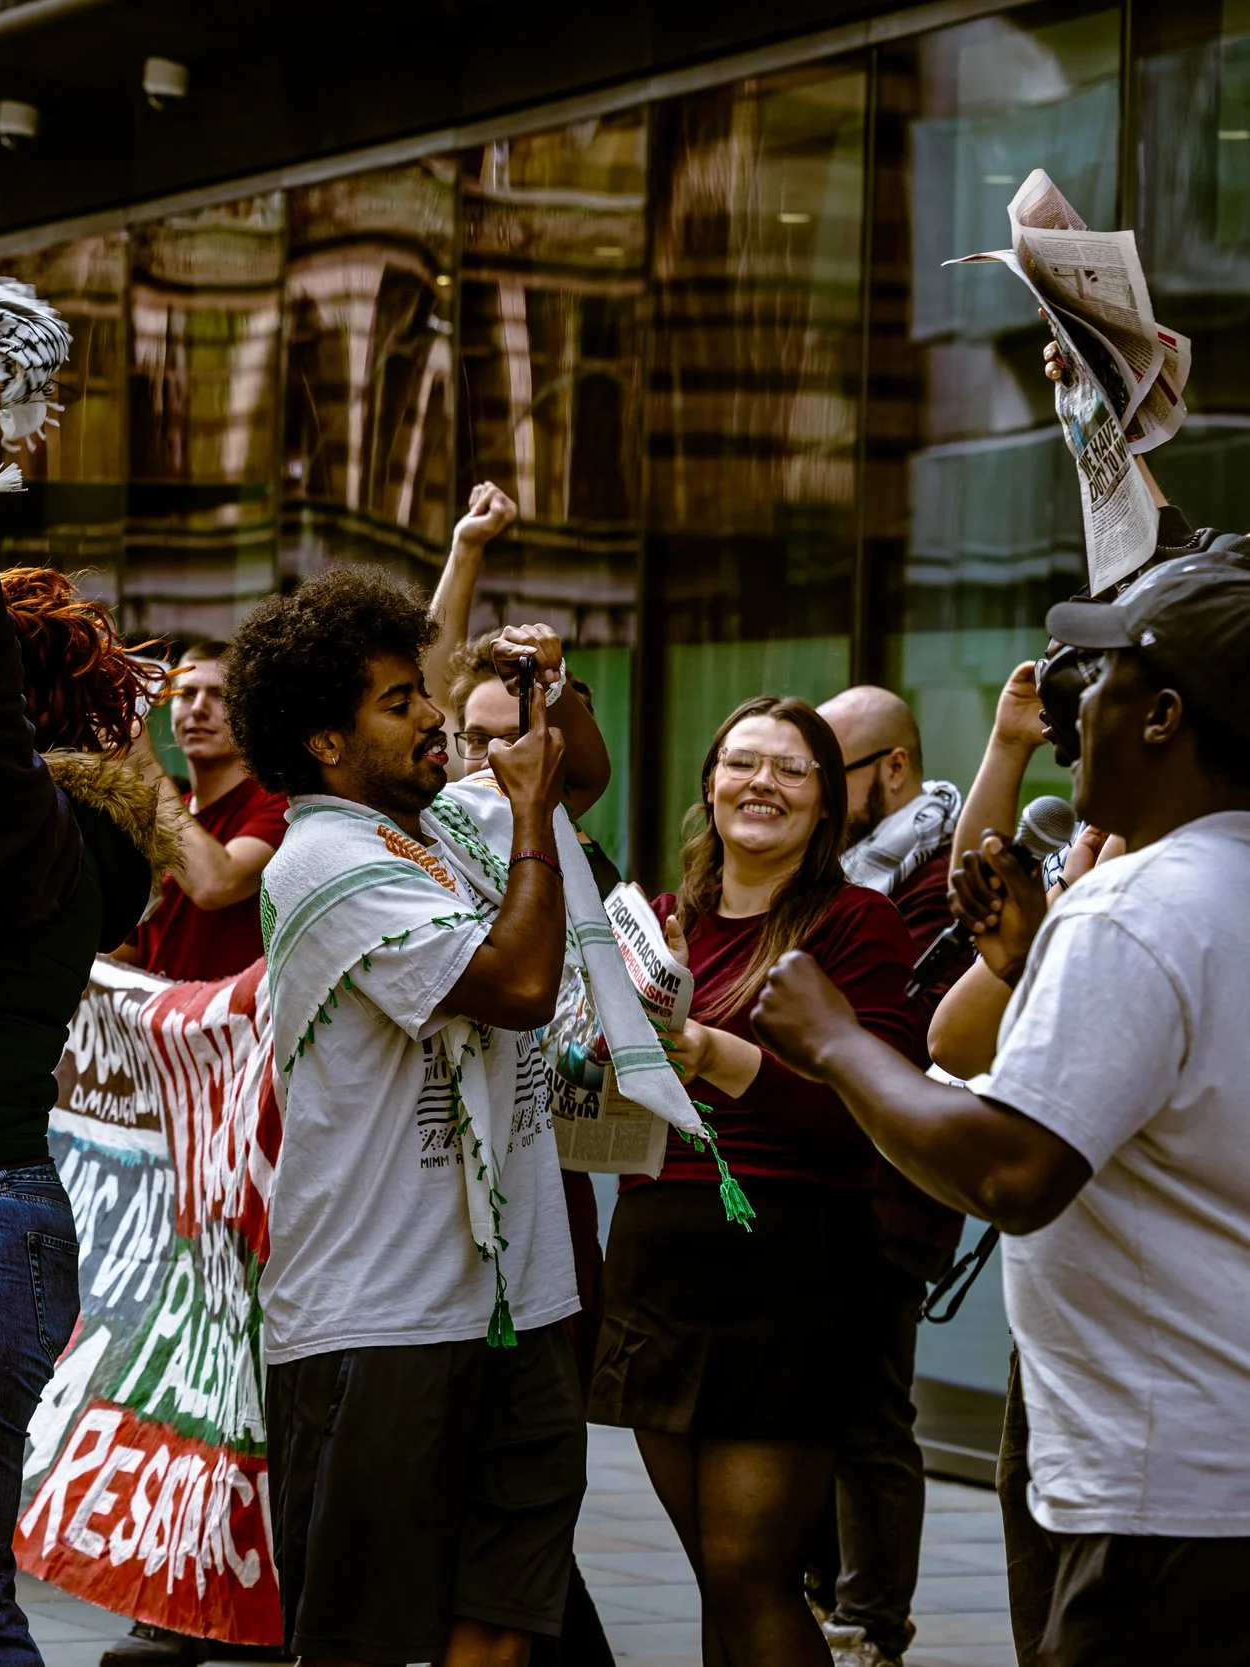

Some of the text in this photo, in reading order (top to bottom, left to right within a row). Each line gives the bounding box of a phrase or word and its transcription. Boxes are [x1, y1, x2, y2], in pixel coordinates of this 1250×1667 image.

[1079, 449, 1097, 481] WE
[1090, 417, 1119, 463] HAVE
[1089, 462, 1110, 503] DUTY
[1103, 450, 1119, 477] TO
[608, 895, 640, 940] FIGHT
[633, 931, 681, 994] RACISM!
[620, 941, 676, 1008] IMPERIALISM!
[543, 1060, 577, 1100] AVE
[582, 1091, 600, 1107] A
[559, 1095, 600, 1120] WIN
